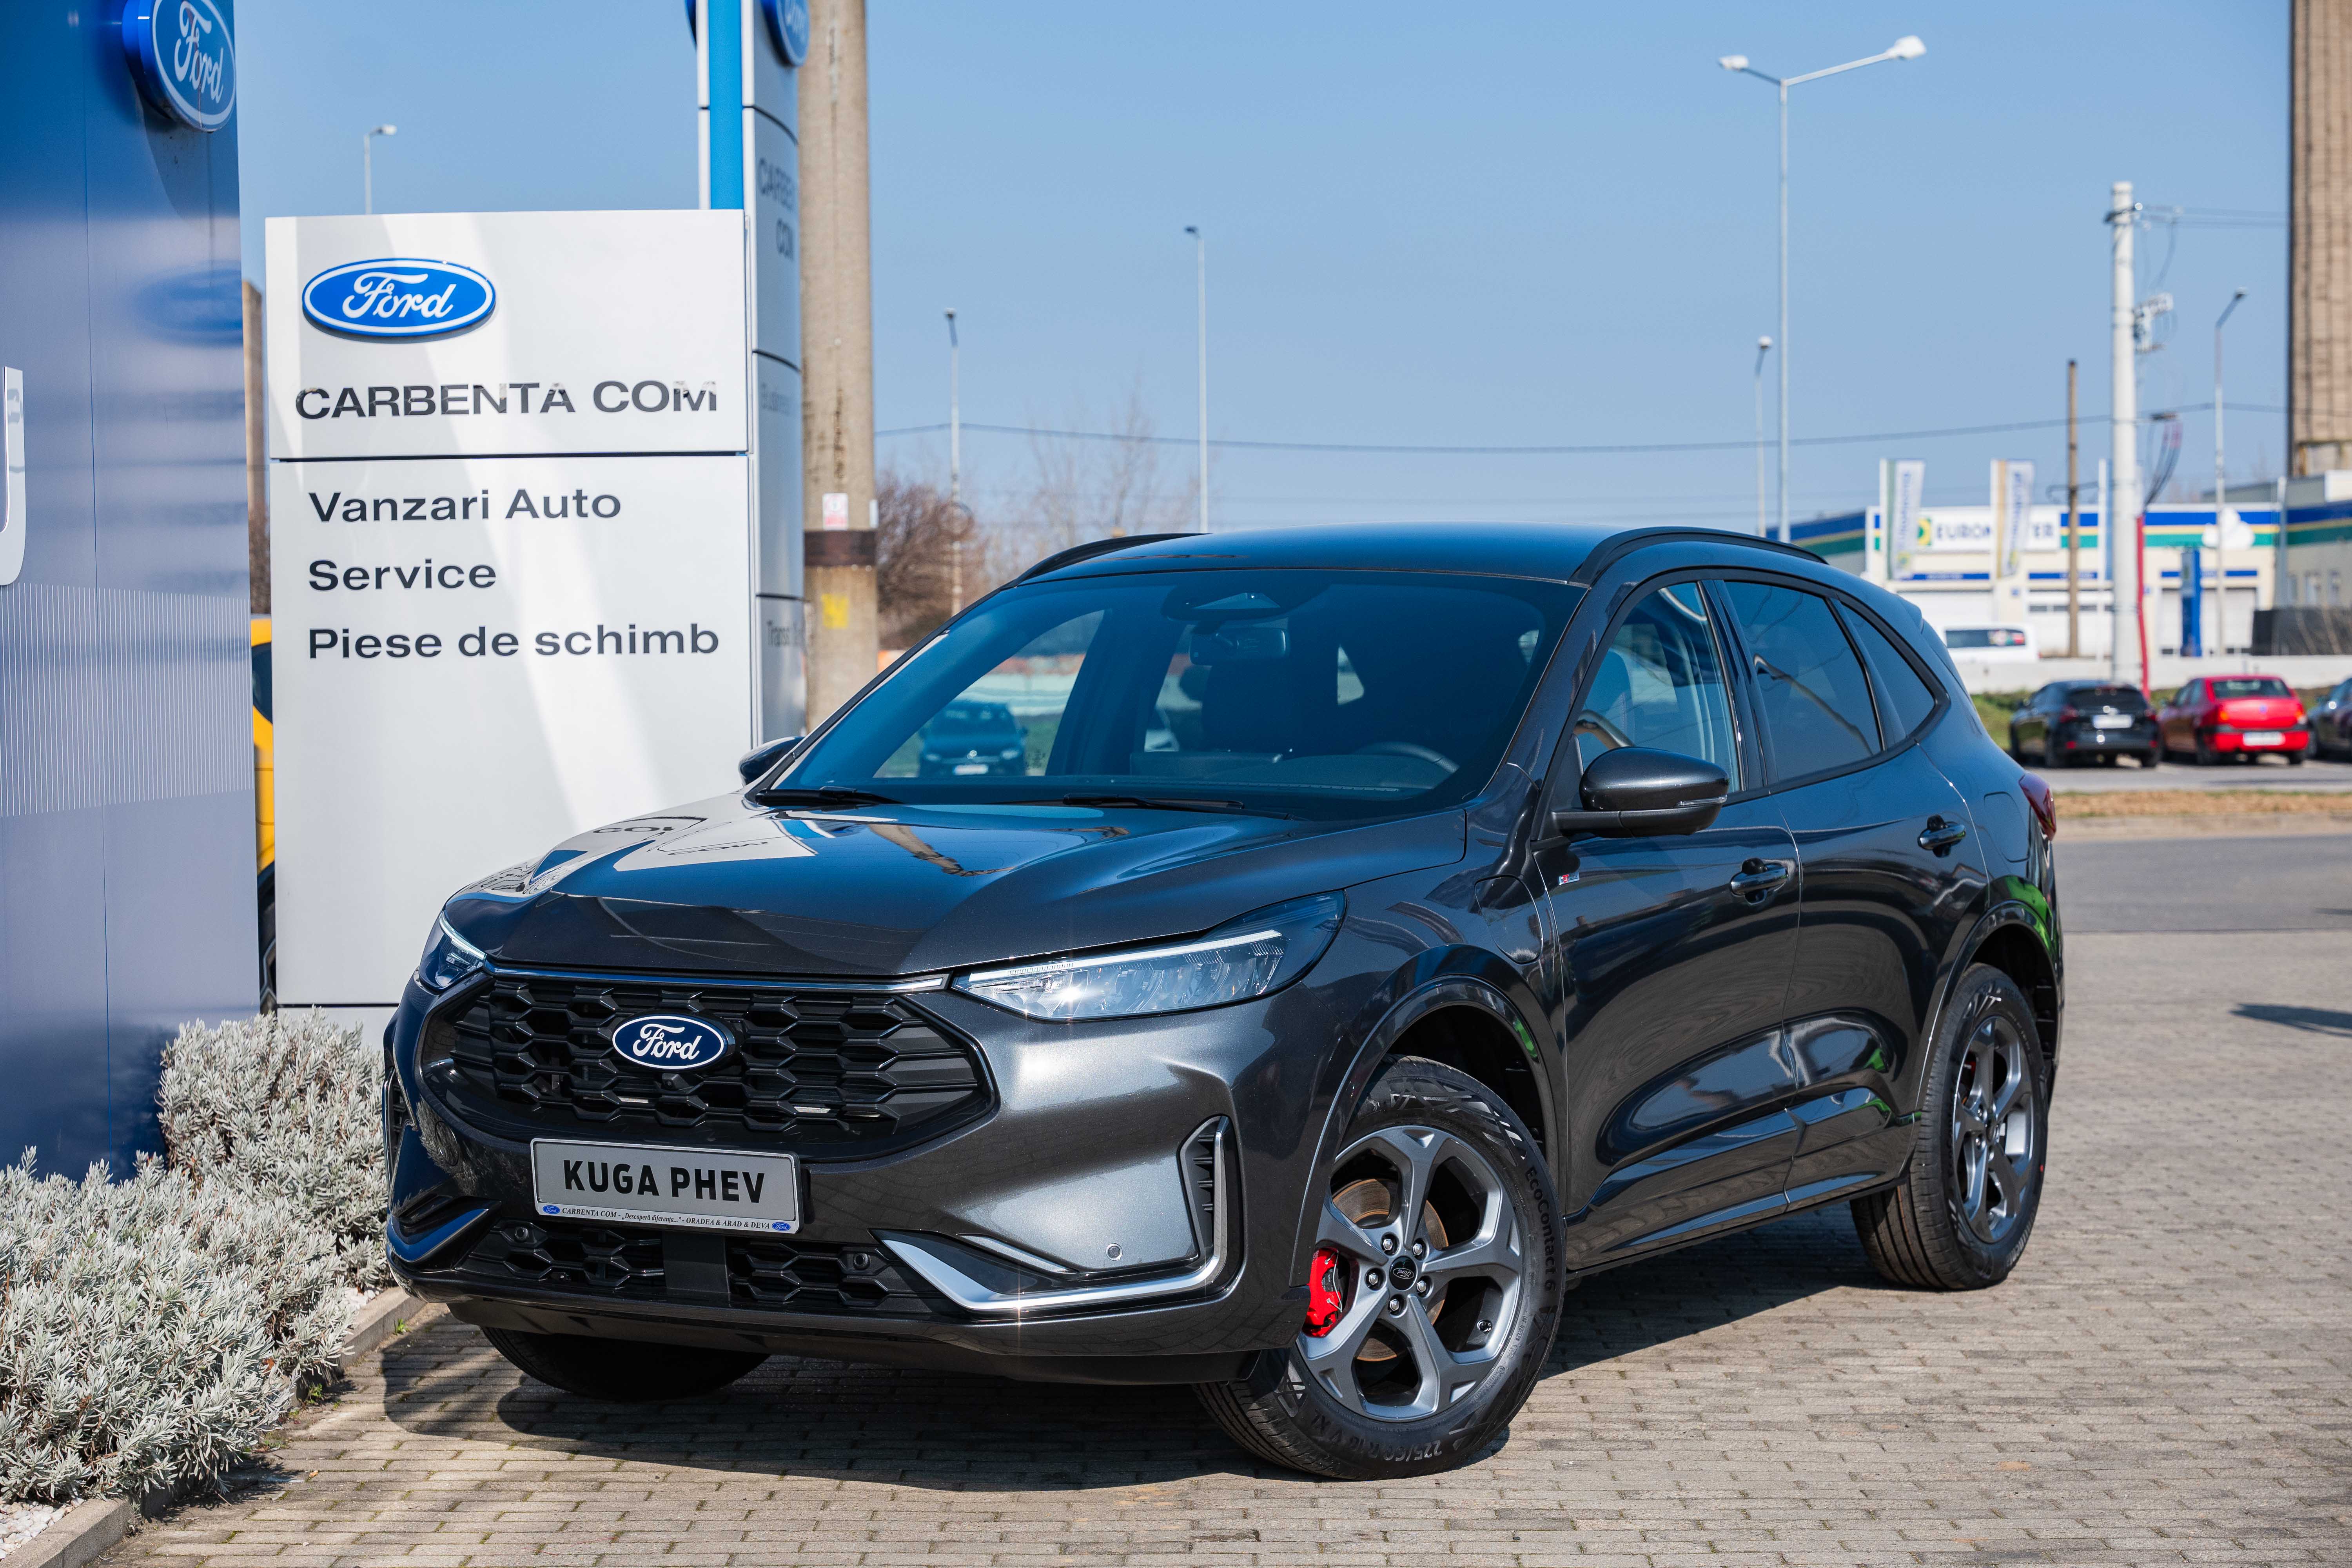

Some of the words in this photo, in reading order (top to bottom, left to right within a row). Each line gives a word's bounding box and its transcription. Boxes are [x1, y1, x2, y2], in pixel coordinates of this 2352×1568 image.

[174, 0, 224, 103] Ford
[342, 272, 456, 319] Ford
[296, 381, 575, 420] CARBENTA
[593, 380, 718, 414] COM
[309, 489, 489, 523] Vanzari
[505, 489, 622, 520] Auto
[309, 559, 496, 591] Service
[310, 627, 442, 659] Piese
[458, 626, 519, 658] de
[535, 623, 719, 656] schimb
[632, 1023, 702, 1060] Ford
[563, 1160, 660, 1196] KUGA
[670, 1166, 766, 1204] PHEV
[562, 1207, 599, 1216] CARBENTA
[686, 1217, 715, 1225] ORADEA
[1526, 1166, 1556, 1274] EcoContact
[1545, 1279, 1556, 1291] 6
[1397, 1269, 1412, 1278] Ford
[1383, 1439, 1442, 1462] 225/60
